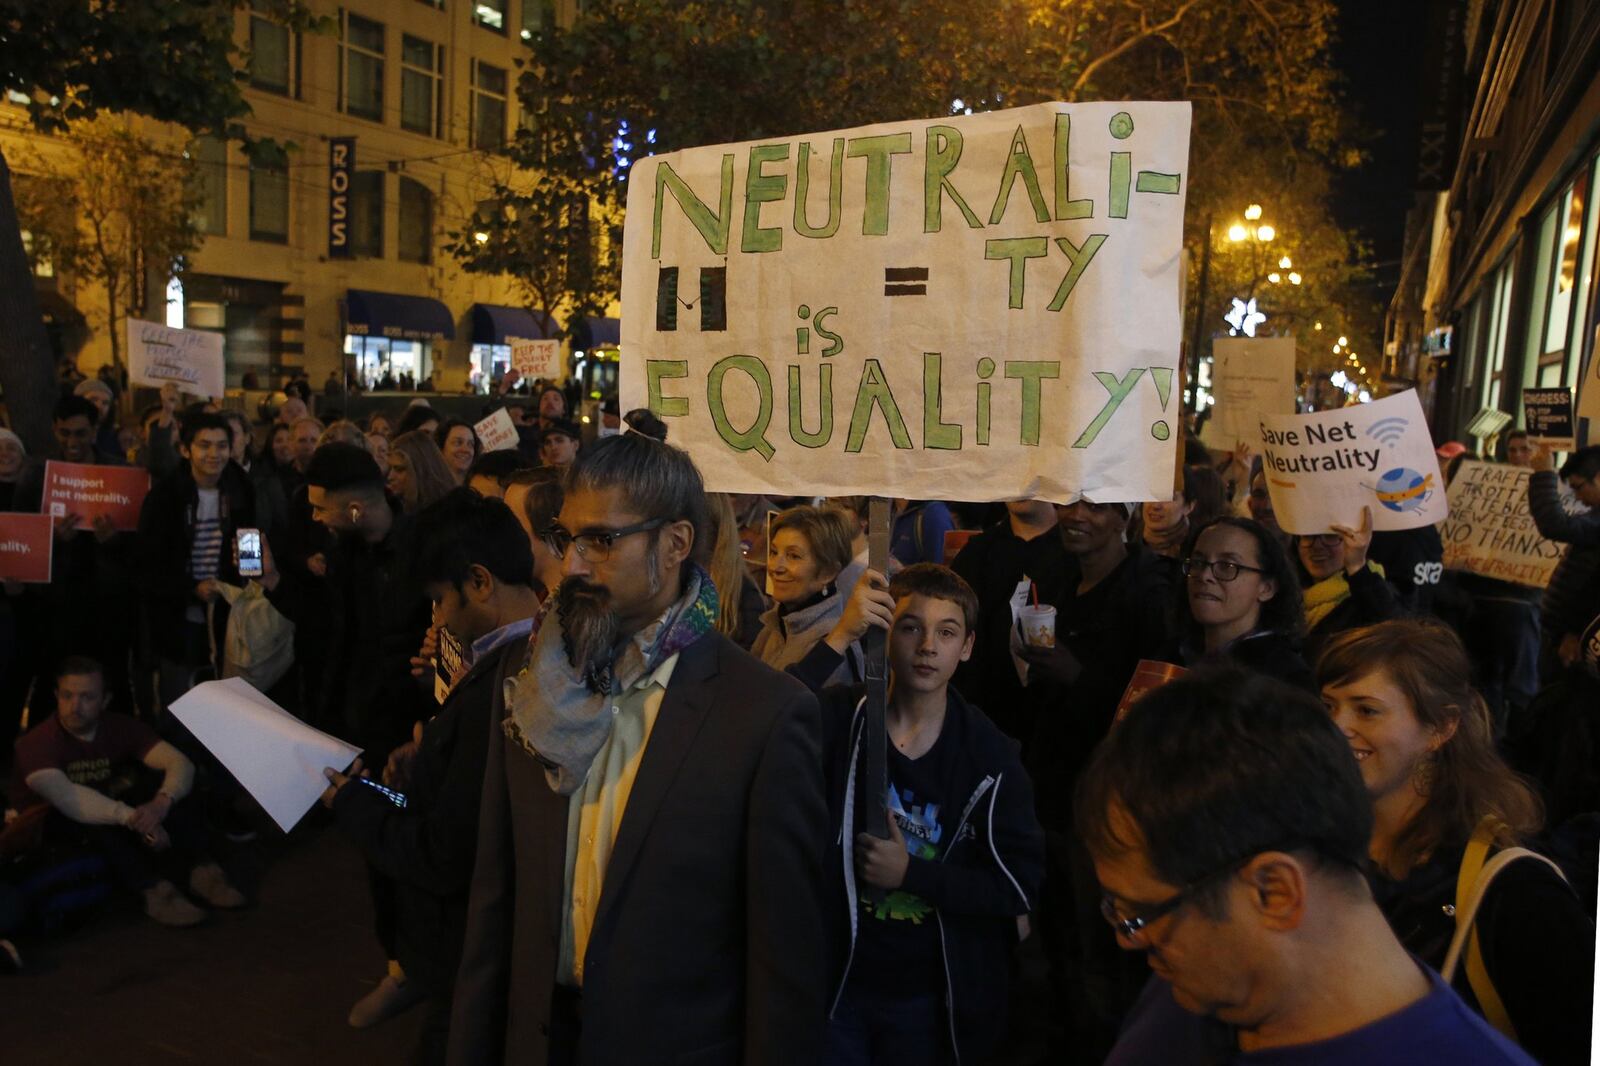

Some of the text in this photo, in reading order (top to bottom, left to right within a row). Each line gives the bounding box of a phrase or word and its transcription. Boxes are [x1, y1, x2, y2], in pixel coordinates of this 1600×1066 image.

[332, 143, 349, 247] ROSS
[651, 111, 1181, 260] NEUTRALI-
[984, 234, 1109, 312] TY
[520, 363, 548, 375] FREE
[646, 352, 1174, 463] EQUALITY!
[1260, 420, 1357, 447] Save Net
[1264, 448, 1380, 474] Neutrality
[53, 474, 104, 489] I support
[1469, 467, 1531, 487] TRAFF
[51, 489, 130, 505] net neutrality.
[1440, 522, 1473, 544] NO
